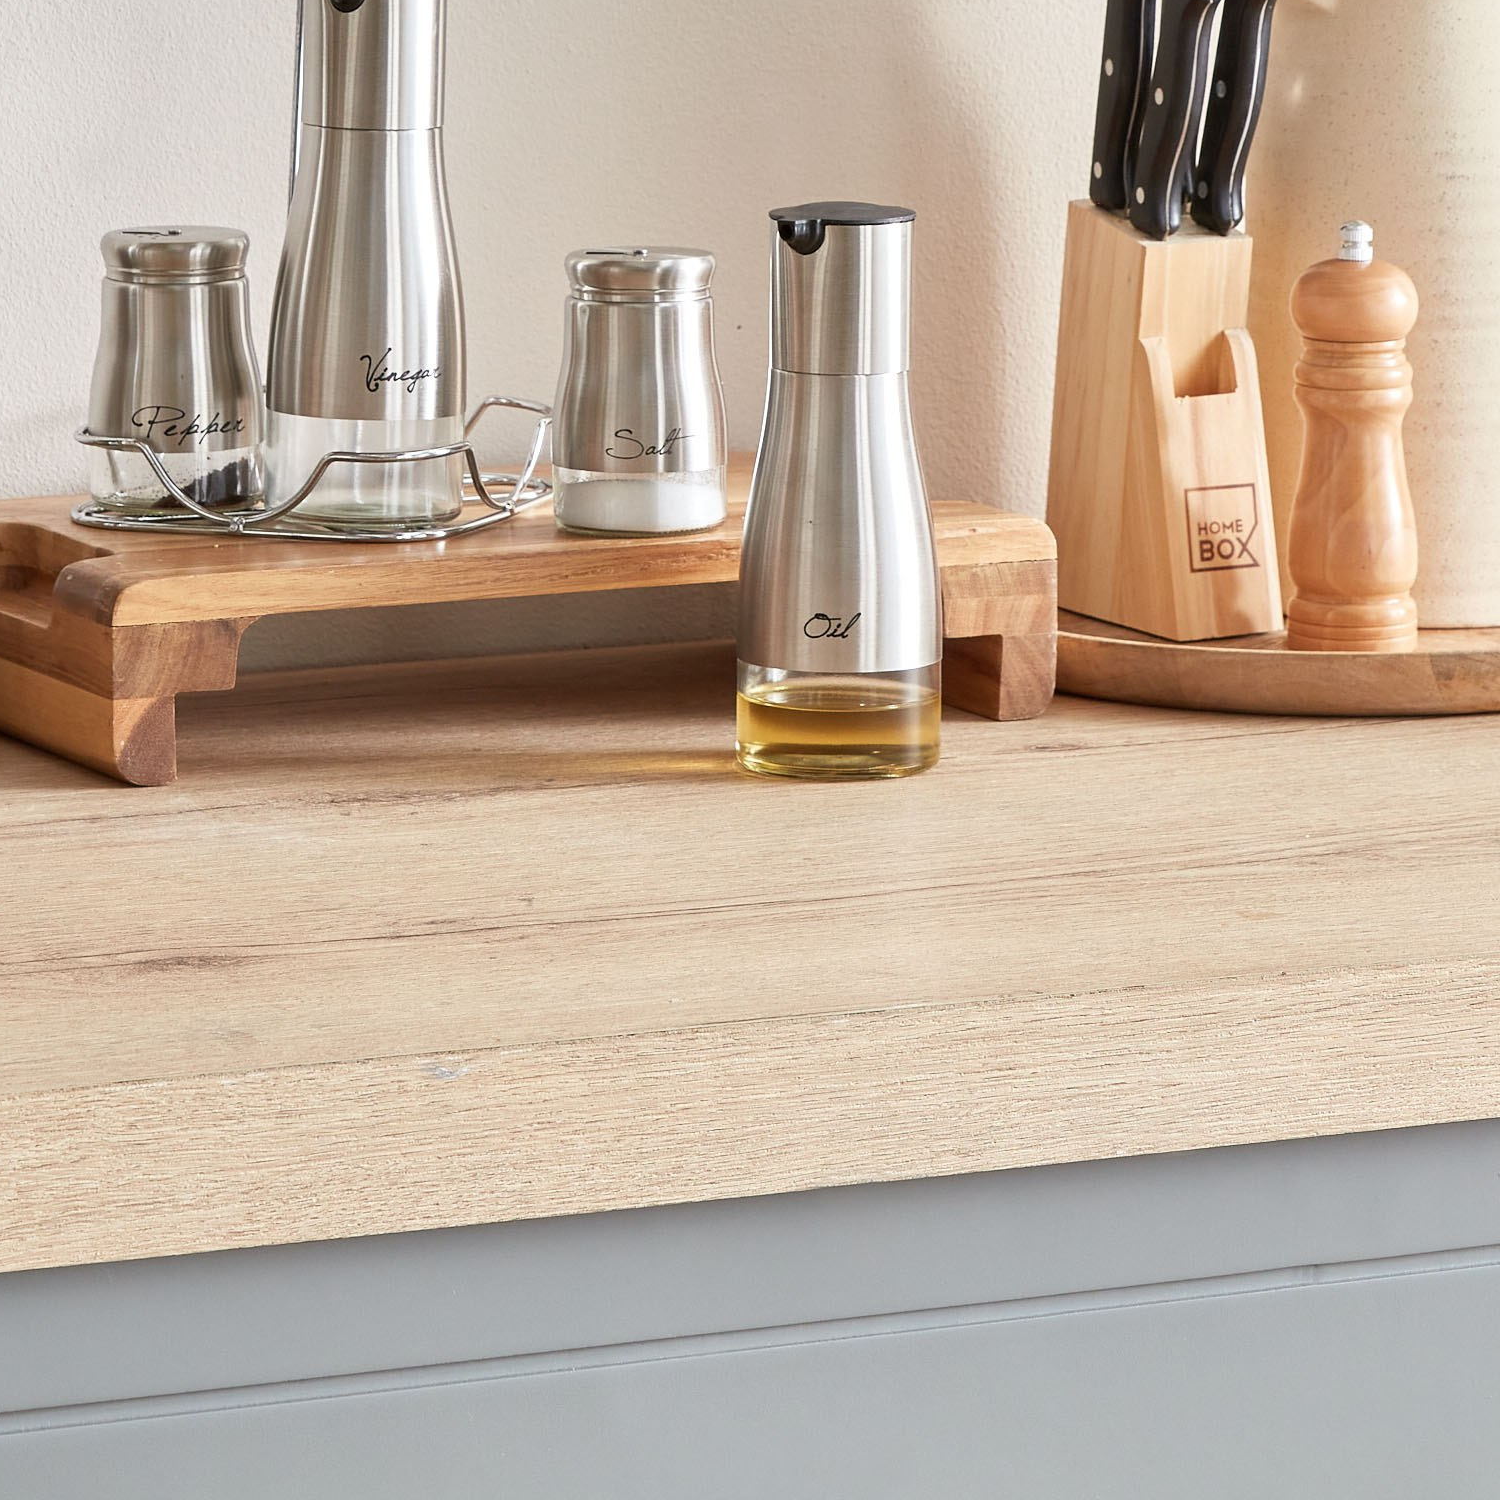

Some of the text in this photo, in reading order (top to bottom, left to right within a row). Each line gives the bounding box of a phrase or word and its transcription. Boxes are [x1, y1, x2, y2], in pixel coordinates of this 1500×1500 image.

[360, 347, 442, 393] Vinegar
[131, 405, 246, 446] Pepper
[605, 427, 695, 460] Salt
[1197, 518, 1243, 536] HOME
[1199, 537, 1254, 562] BOX
[803, 612, 862, 640] Oil
